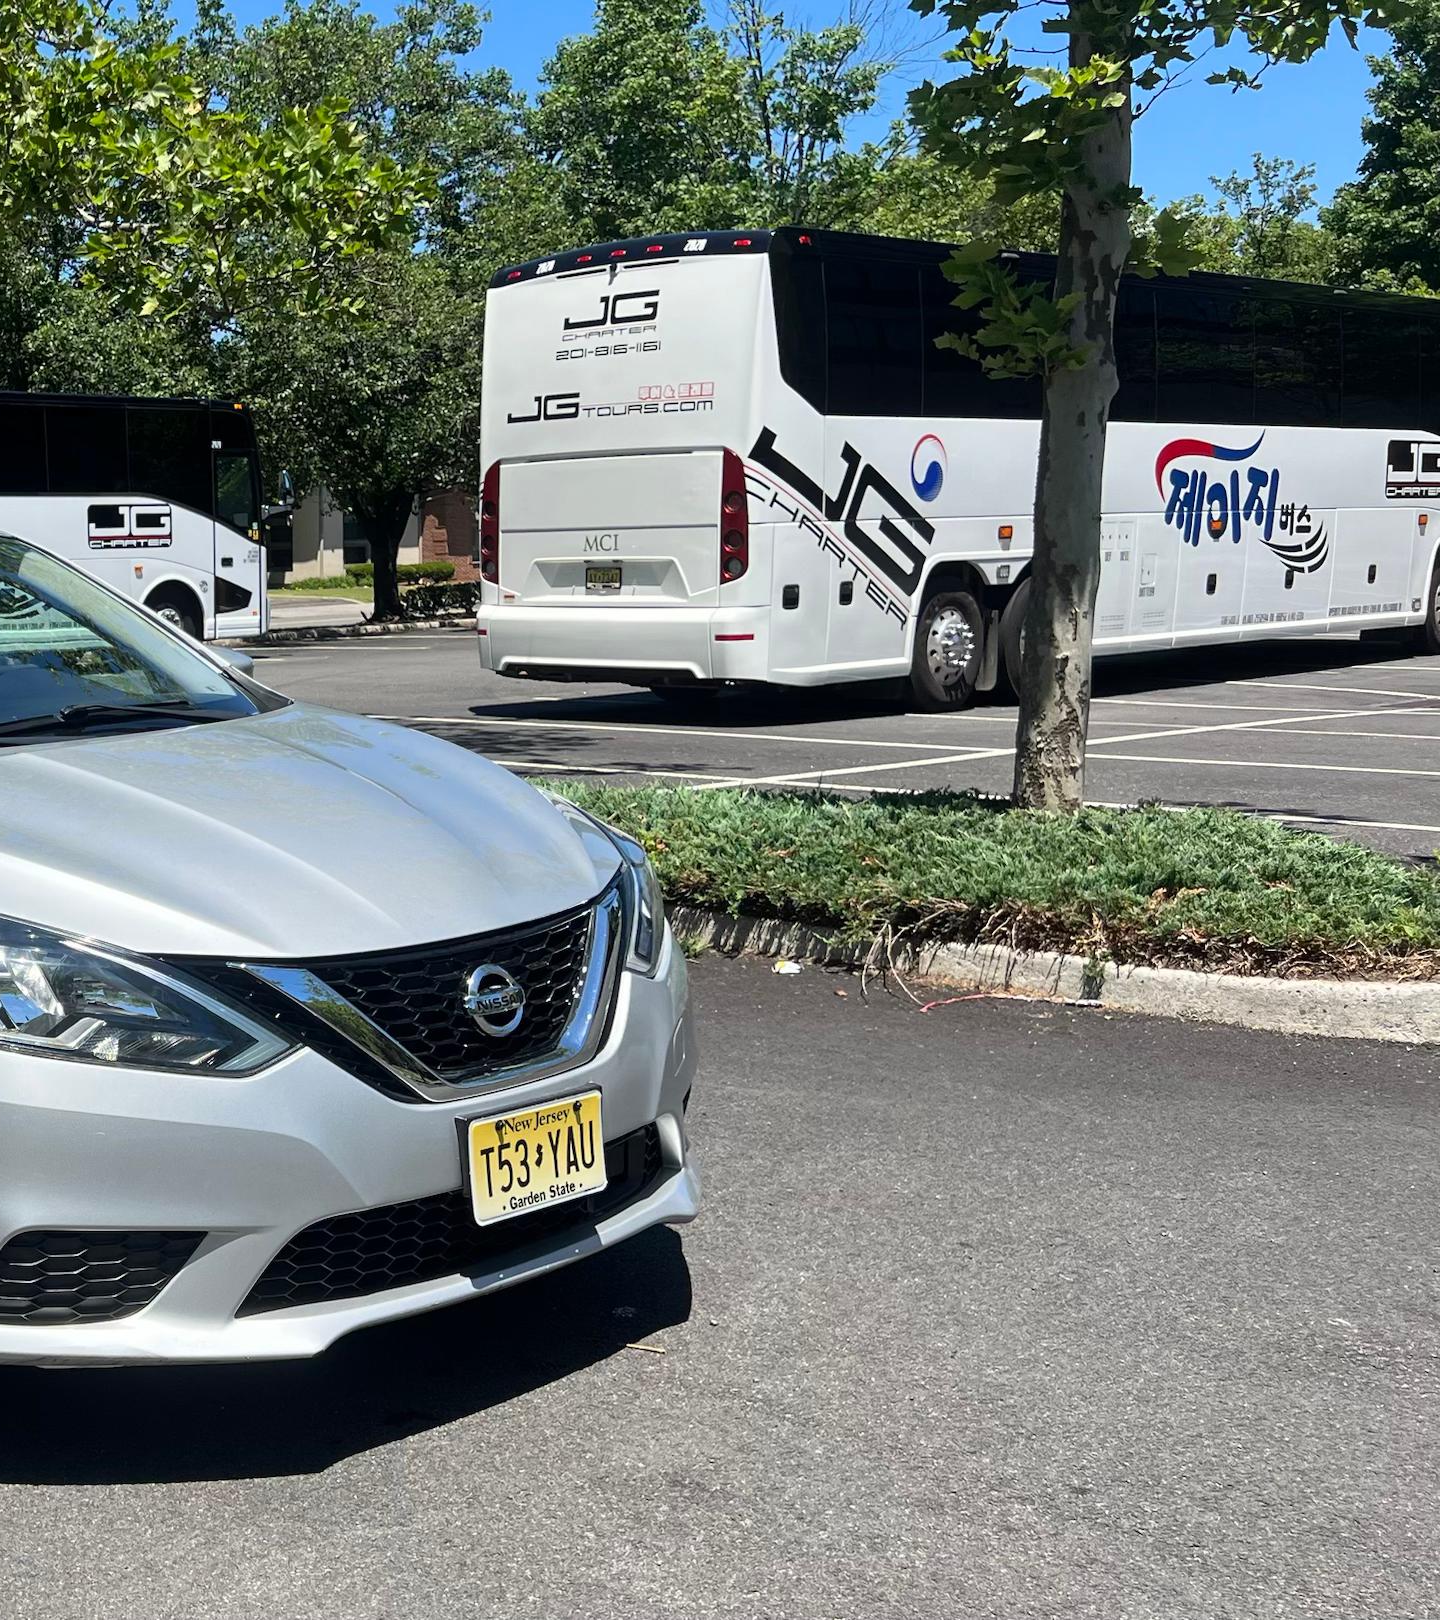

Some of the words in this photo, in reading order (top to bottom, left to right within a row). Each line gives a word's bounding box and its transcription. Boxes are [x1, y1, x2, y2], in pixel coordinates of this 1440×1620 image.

[563, 290, 660, 330] JG
[562, 325, 657, 342] CHARTER
[556, 341, 661, 361] 201-816-1161
[1386, 487, 1440, 496] CHARTE
[88, 506, 171, 537] JG
[748, 426, 936, 597] JG
[1164, 467, 1280, 548] 제이지
[1279, 502, 1311, 536] 버스
[89, 539, 171, 549] CHARTER
[583, 534, 620, 552] MCI
[744, 474, 907, 631] CHARTER
[503, 1118, 533, 1136] New
[534, 1109, 571, 1131] Jersey
[509, 1190, 546, 1210] Garden
[549, 1181, 576, 1198] State
